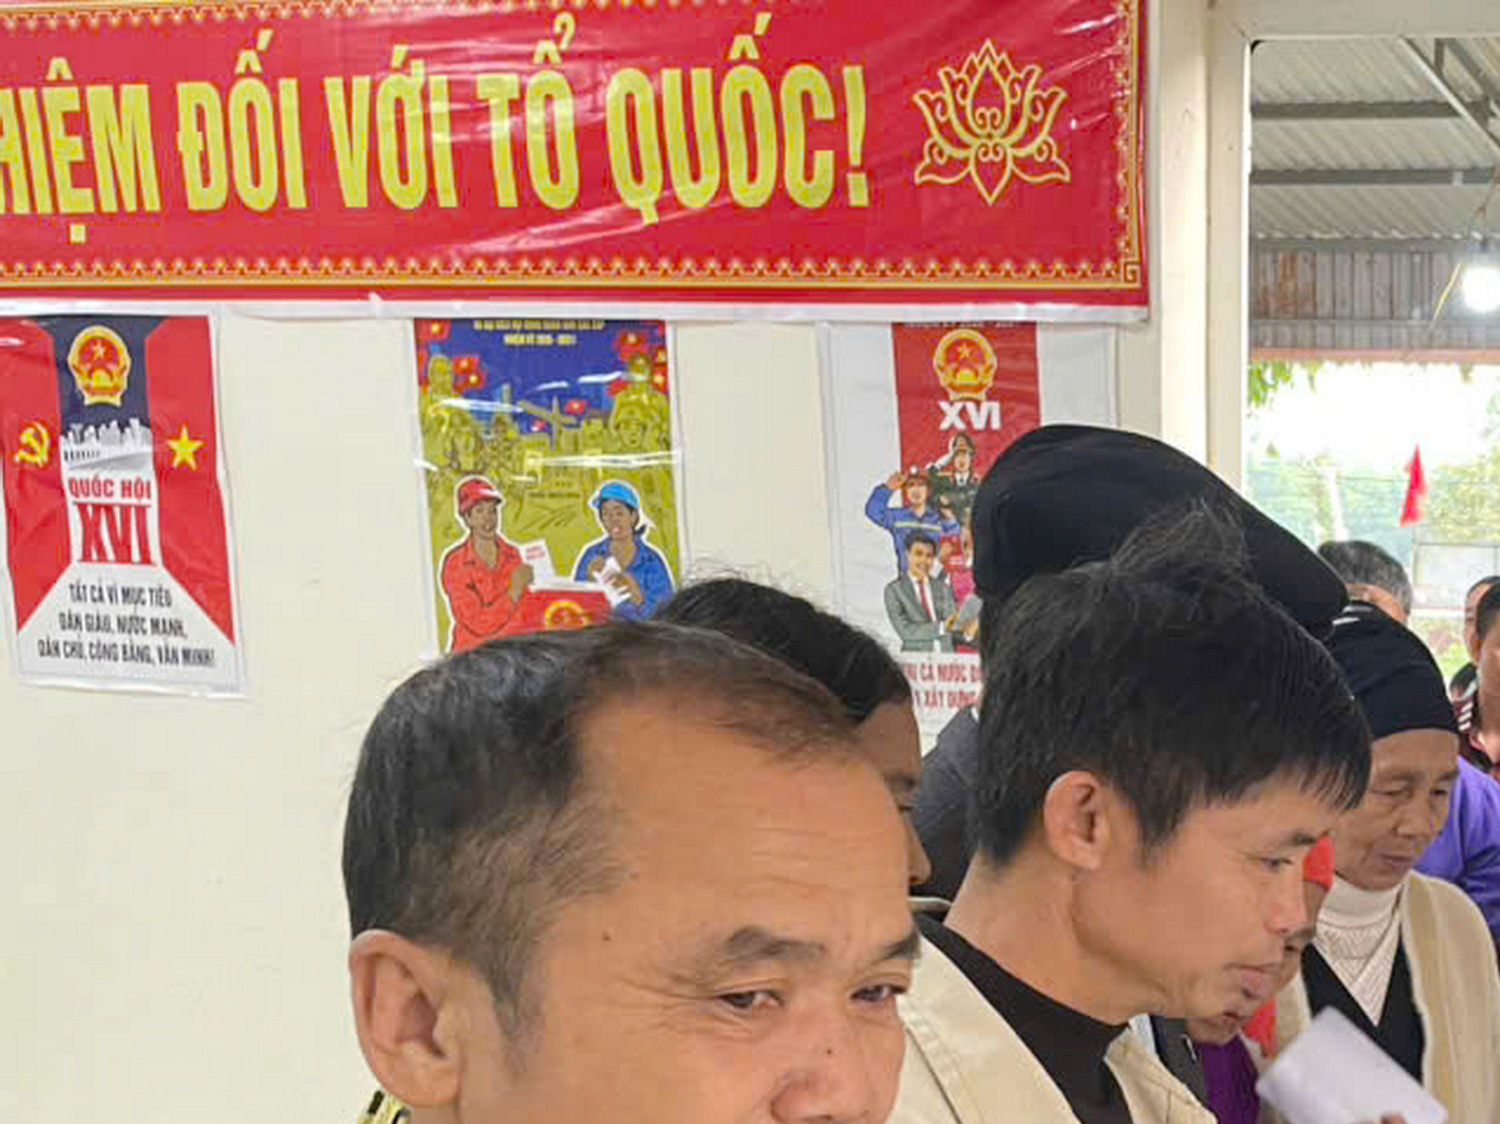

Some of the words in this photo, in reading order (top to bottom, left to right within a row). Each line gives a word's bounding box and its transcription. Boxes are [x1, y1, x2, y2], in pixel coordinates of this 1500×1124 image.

[177, 28, 302, 216] ĐỐI
[324, 45, 452, 211] VỚI
[476, 11, 580, 208] TỔ
[605, 11, 870, 226] QUỐC!
[938, 401, 1001, 431] XVI
[69, 474, 114, 499] QUỐC
[73, 501, 157, 566] XVI
